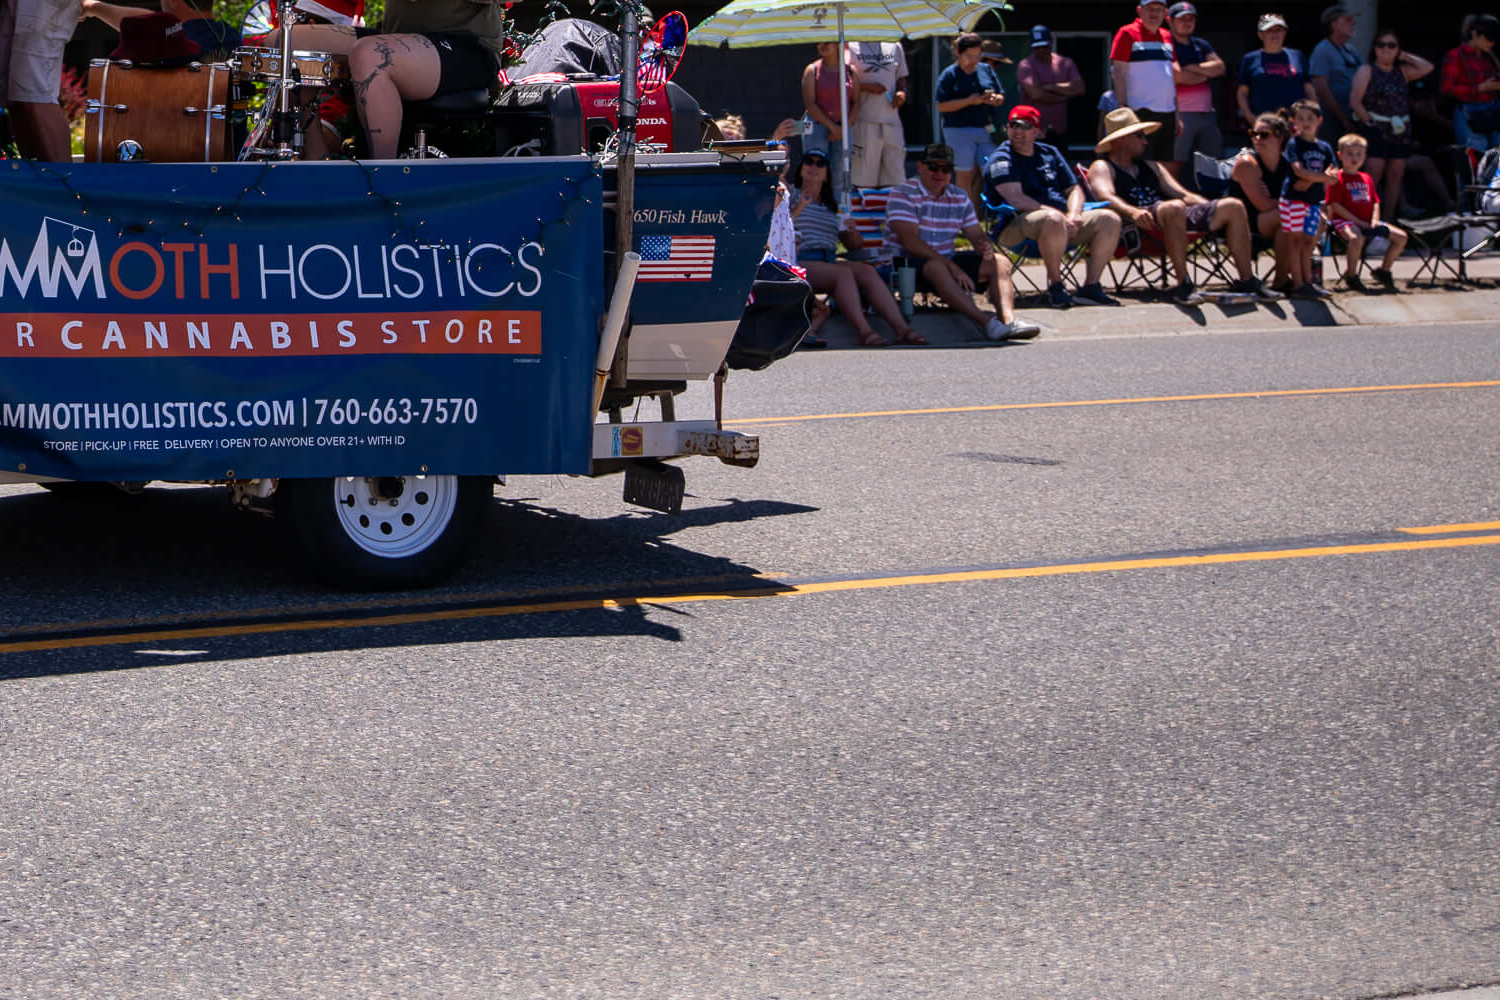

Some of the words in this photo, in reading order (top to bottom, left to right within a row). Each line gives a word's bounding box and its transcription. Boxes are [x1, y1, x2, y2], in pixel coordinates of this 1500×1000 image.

[636, 117, 668, 126] ONDA
[658, 208, 685, 224] Fish
[690, 208, 728, 224] Hawk
[258, 241, 543, 300] HOLISTICS
[60, 319, 357, 350] CANNABIS
[381, 318, 522, 344] STORE
[314, 397, 478, 425] 760-663-7570
[43, 440, 79, 451] STORE
[85, 440, 127, 451] PICK-UP
[133, 440, 160, 450] FREE
[164, 439, 214, 449] DELIVERY
[220, 438, 251, 449] OPEN
[252, 437, 268, 448] TO
[269, 437, 314, 448] ANYONE
[316, 436, 346, 447] OVER
[347, 436, 365, 446] 21+
[367, 435, 393, 446] WITH
[394, 435, 406, 446] ID
